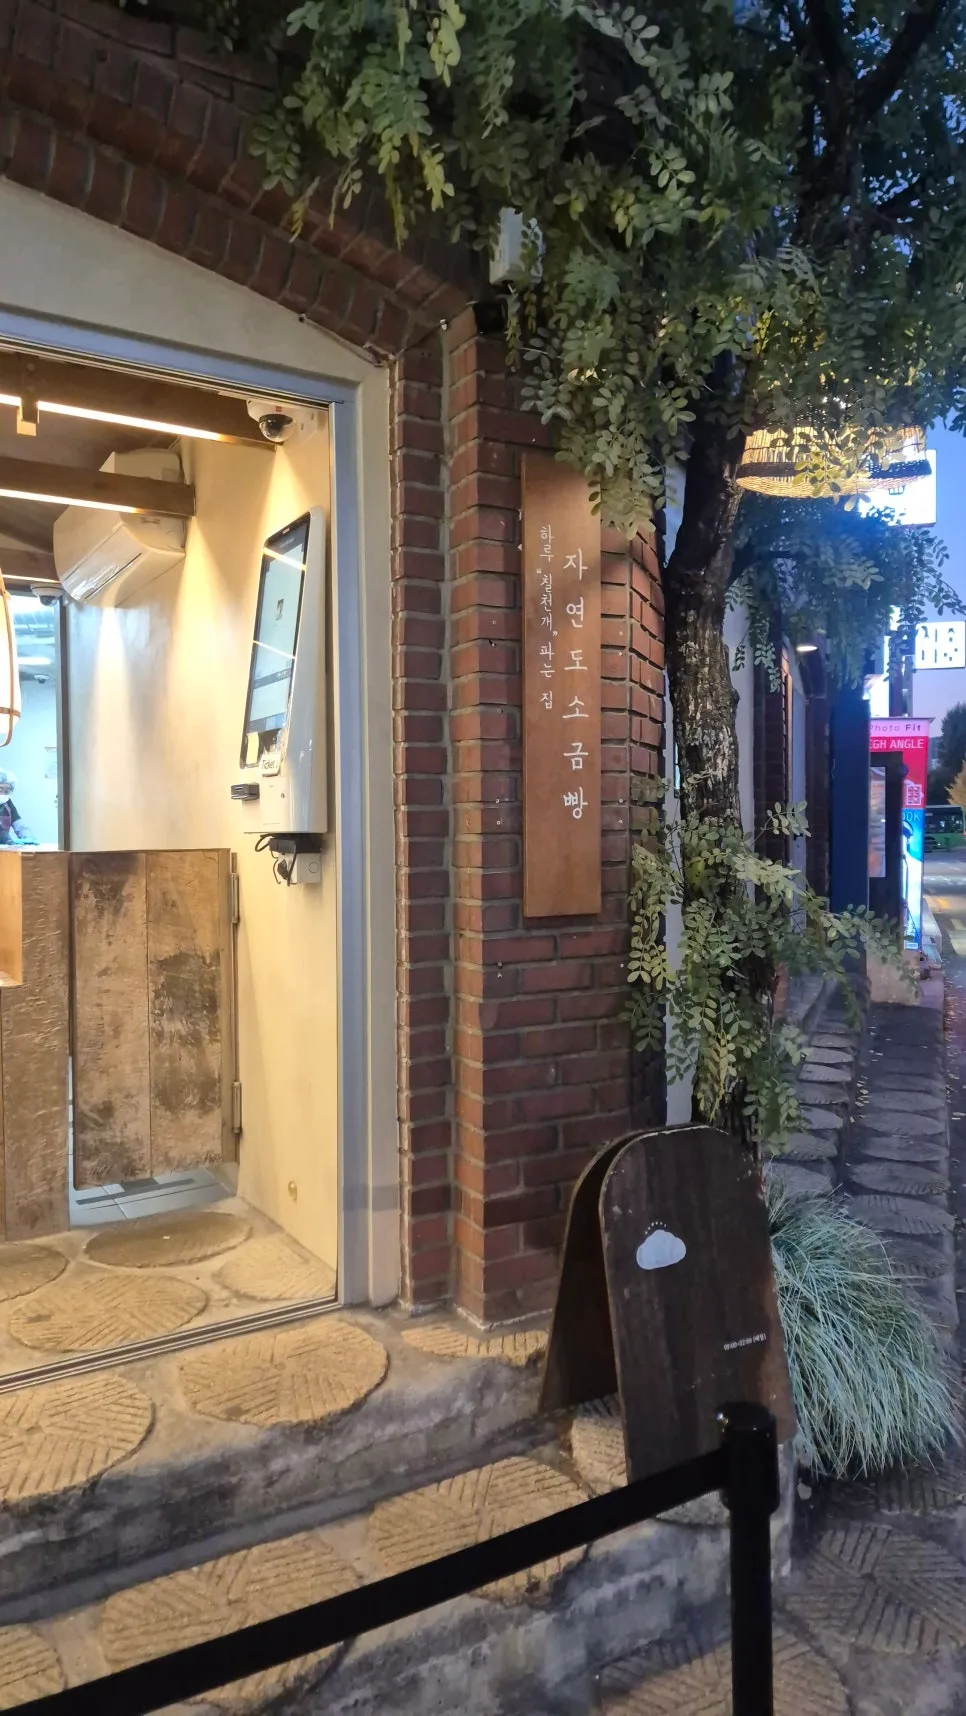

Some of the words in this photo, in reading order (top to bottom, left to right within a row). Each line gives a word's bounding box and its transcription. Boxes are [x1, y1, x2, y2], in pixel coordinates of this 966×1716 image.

[540, 525, 554, 562] 하루
[539, 641, 555, 678] 파는
[539, 690, 553, 709] 집
[890, 739, 925, 749] ANGLE
